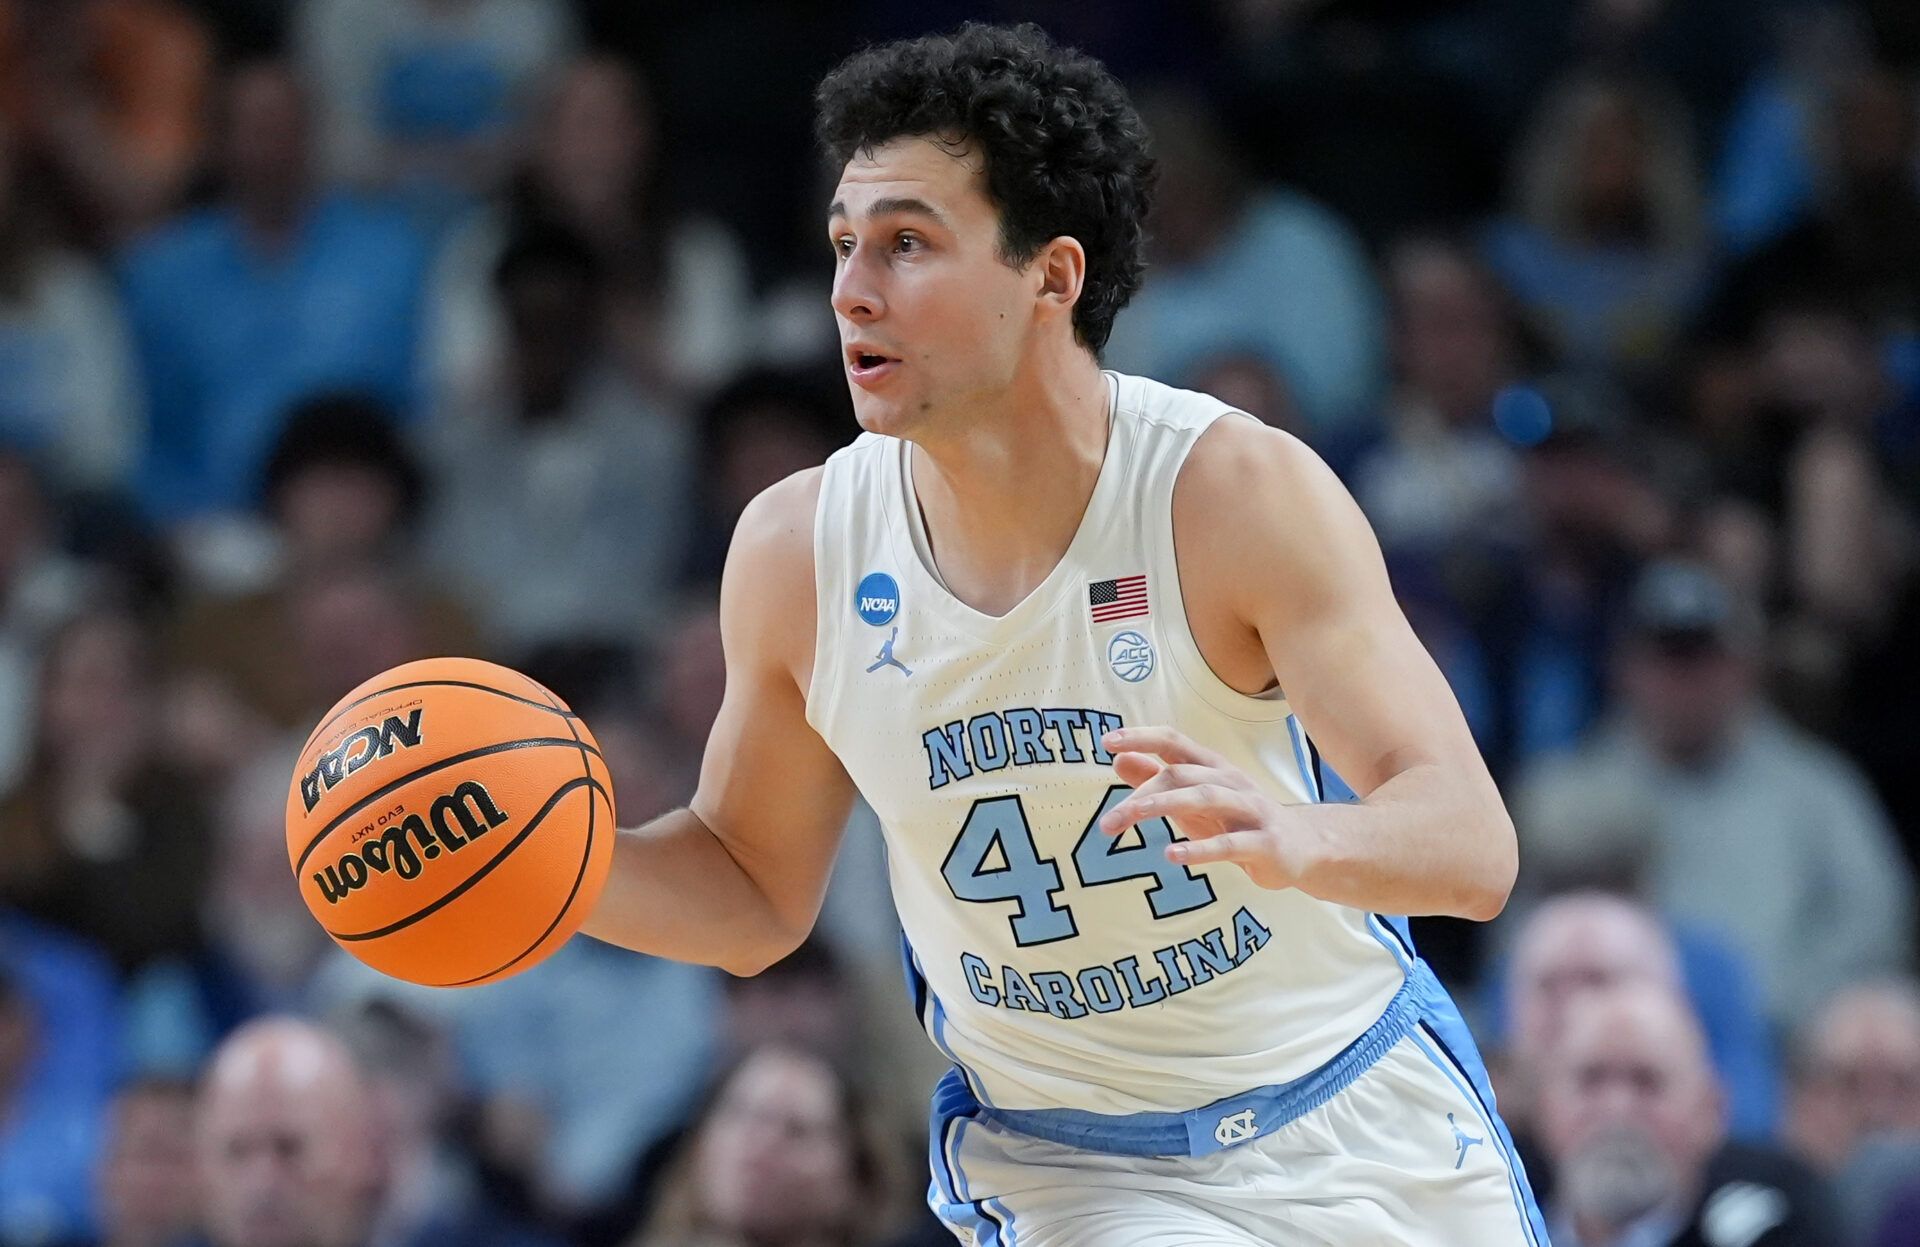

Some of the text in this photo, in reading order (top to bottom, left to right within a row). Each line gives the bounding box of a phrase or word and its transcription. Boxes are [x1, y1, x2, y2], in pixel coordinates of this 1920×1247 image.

[860, 597, 896, 613] NCAA
[1115, 645, 1149, 661] ACC
[300, 708, 423, 814] NCAA
[922, 707, 1125, 791] NORTH
[313, 779, 509, 905] Wilson
[351, 804, 405, 844] EVO NXT
[940, 784, 1218, 948] 44
[960, 905, 1273, 1020] CAROLINA
